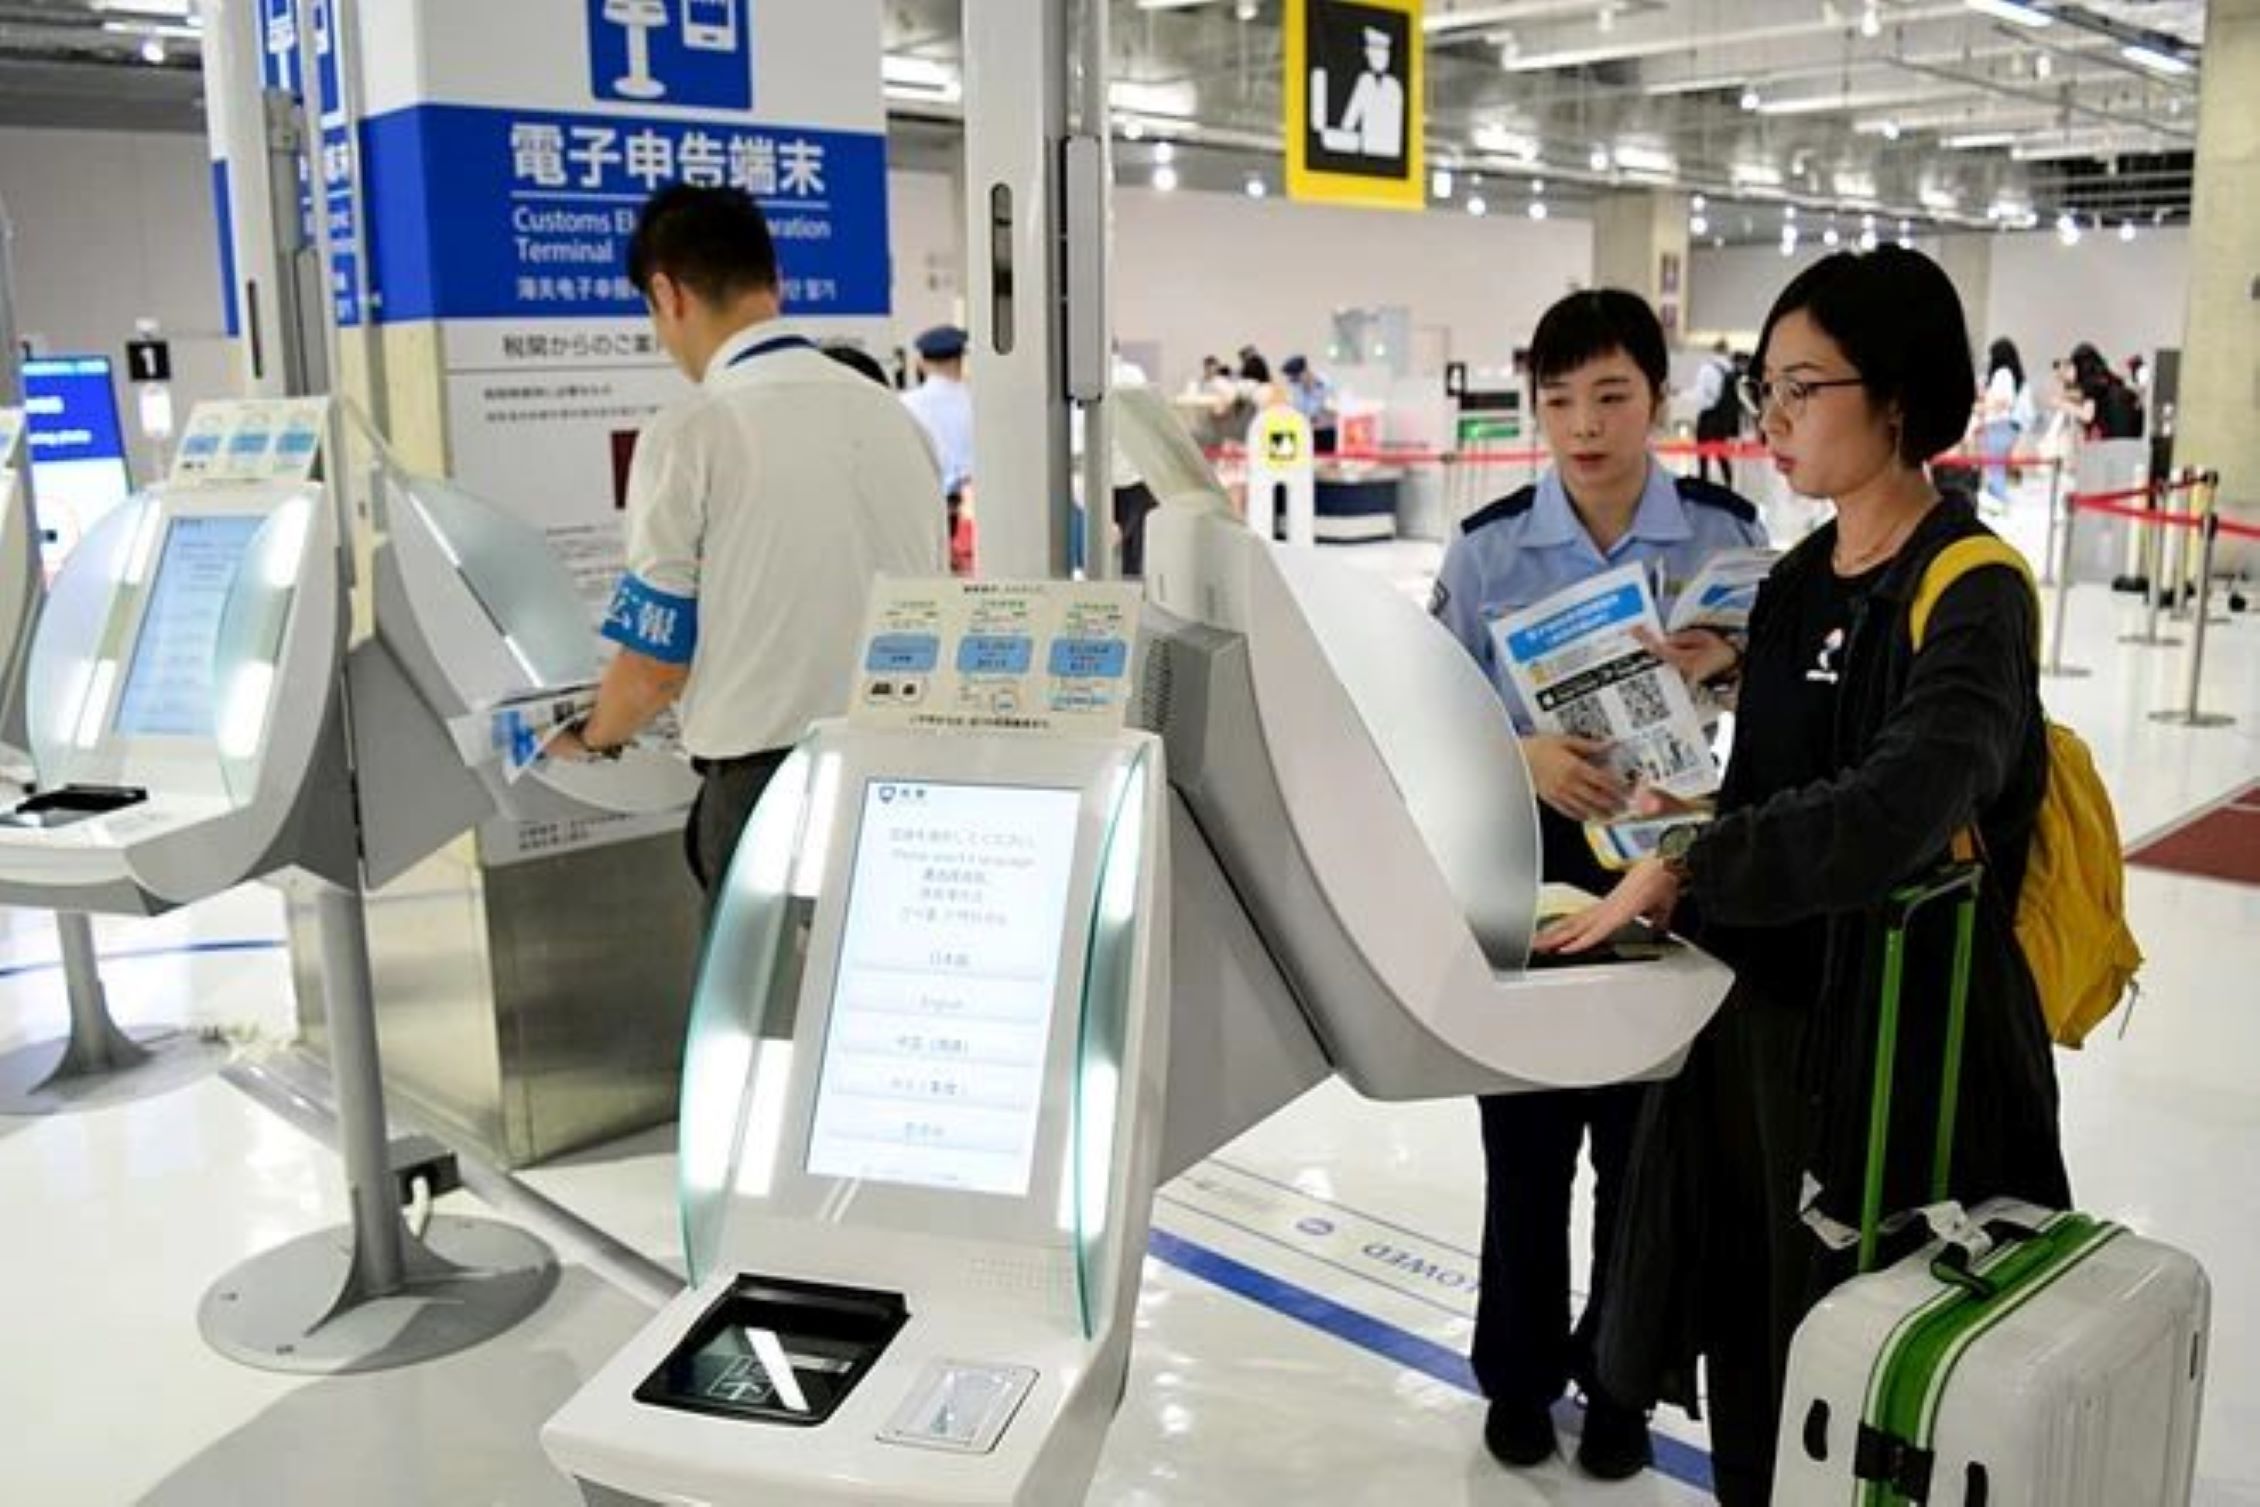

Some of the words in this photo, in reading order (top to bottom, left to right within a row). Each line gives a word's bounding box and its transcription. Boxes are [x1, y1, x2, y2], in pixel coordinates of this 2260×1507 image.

[510, 122, 826, 196] 電子申告端末
[512, 206, 609, 233] Customs
[515, 236, 613, 263] Terminal
[502, 333, 660, 359] 税関からのご案
[140, 347, 157, 376] 1
